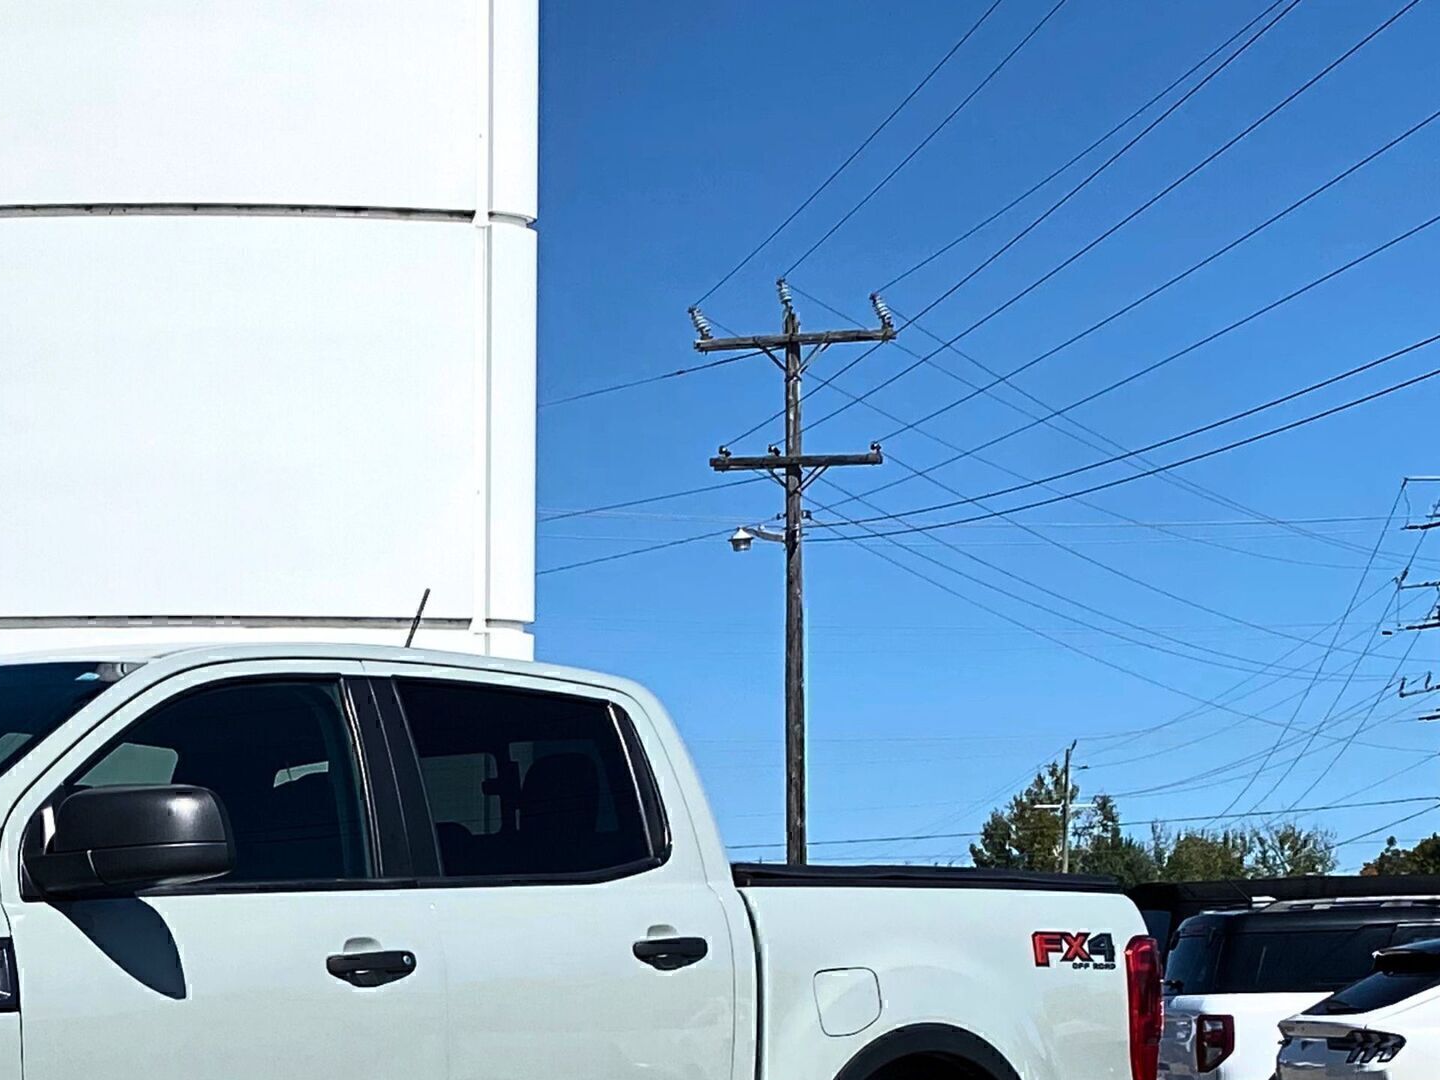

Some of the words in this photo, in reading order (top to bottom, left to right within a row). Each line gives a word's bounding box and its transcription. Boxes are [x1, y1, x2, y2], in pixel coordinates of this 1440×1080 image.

[1031, 931, 1115, 968] FX4
[1072, 962, 1090, 970] OFF
[1092, 962, 1117, 970] ROAD
